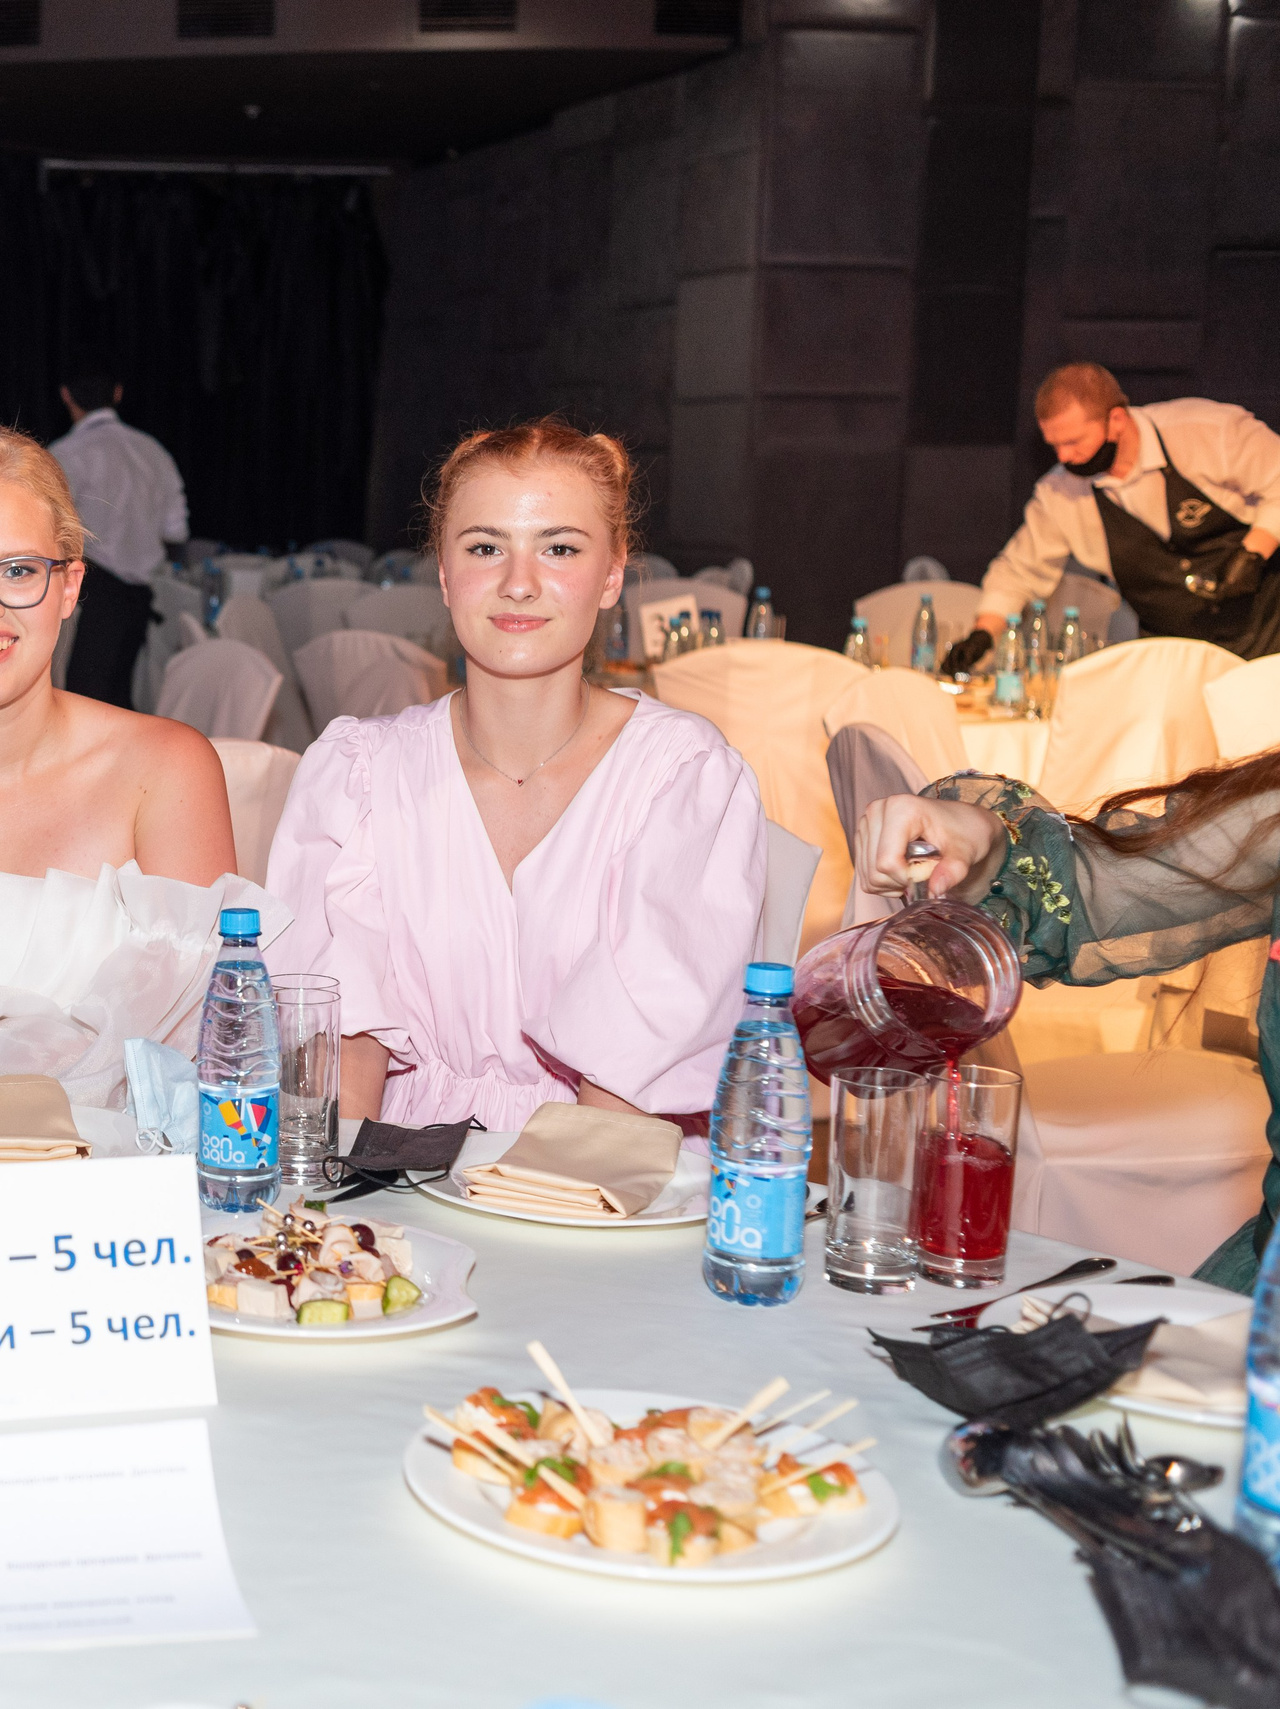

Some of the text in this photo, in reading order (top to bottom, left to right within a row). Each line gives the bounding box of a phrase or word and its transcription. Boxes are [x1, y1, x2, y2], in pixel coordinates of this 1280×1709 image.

[202, 1130, 233, 1150] bon
[202, 1146, 246, 1165] aqua
[710, 1195, 741, 1225] on
[709, 1216, 763, 1249] qua
[53, 1234, 77, 1272] 5
[93, 1235, 192, 1268] чел.
[70, 1310, 92, 1345] 5
[106, 1312, 196, 1342] чел.
